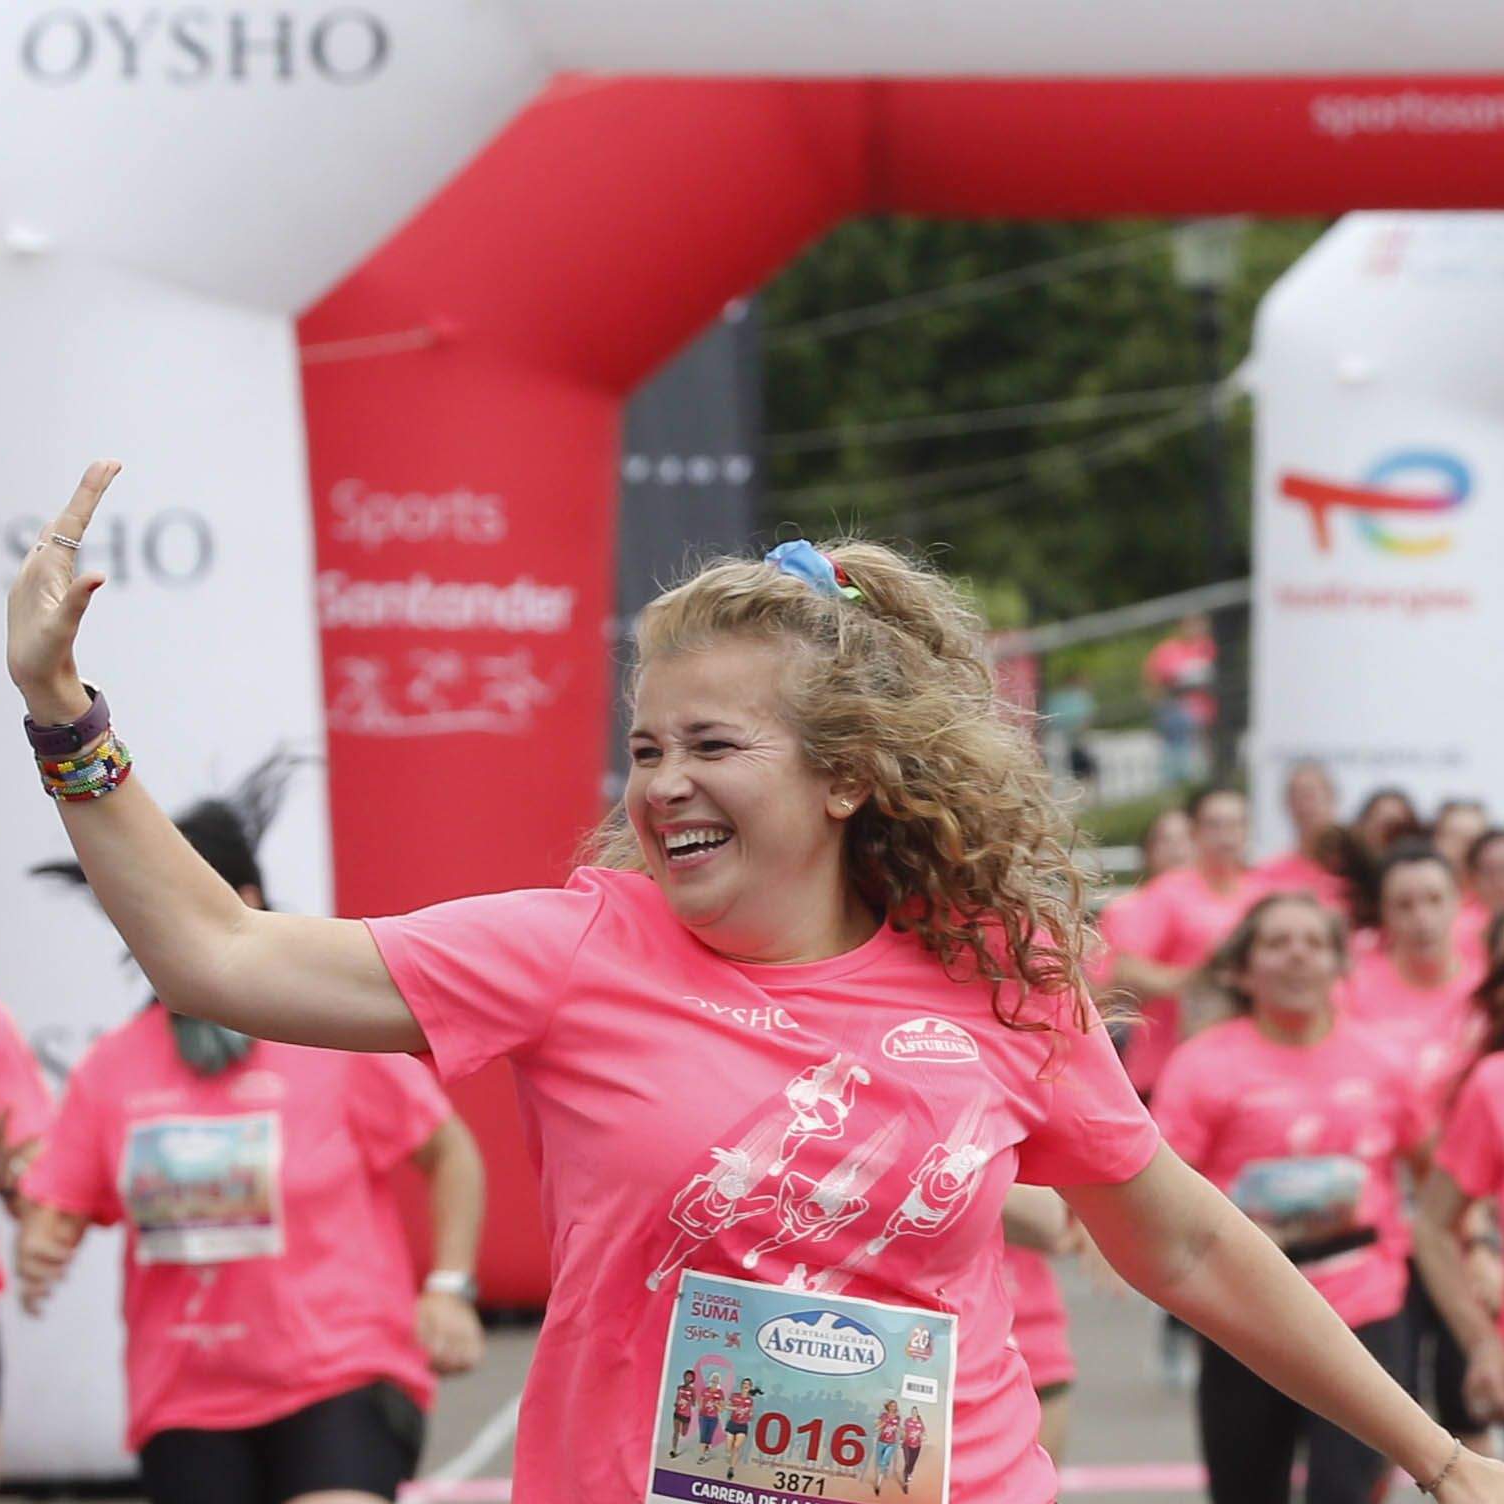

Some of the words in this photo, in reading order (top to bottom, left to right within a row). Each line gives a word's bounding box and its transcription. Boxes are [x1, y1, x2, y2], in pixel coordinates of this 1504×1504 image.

[21, 5, 393, 87] OYSHO
[330, 477, 509, 551] Sports
[317, 569, 578, 634] Santander
[690, 1302, 740, 1324] SUMA
[692, 1291, 705, 1301] TU
[705, 1293, 743, 1309] DORSAL
[765, 1327, 877, 1366] ASTURIANA
[755, 1411, 867, 1467] 016
[772, 1471, 826, 1496] 3871
